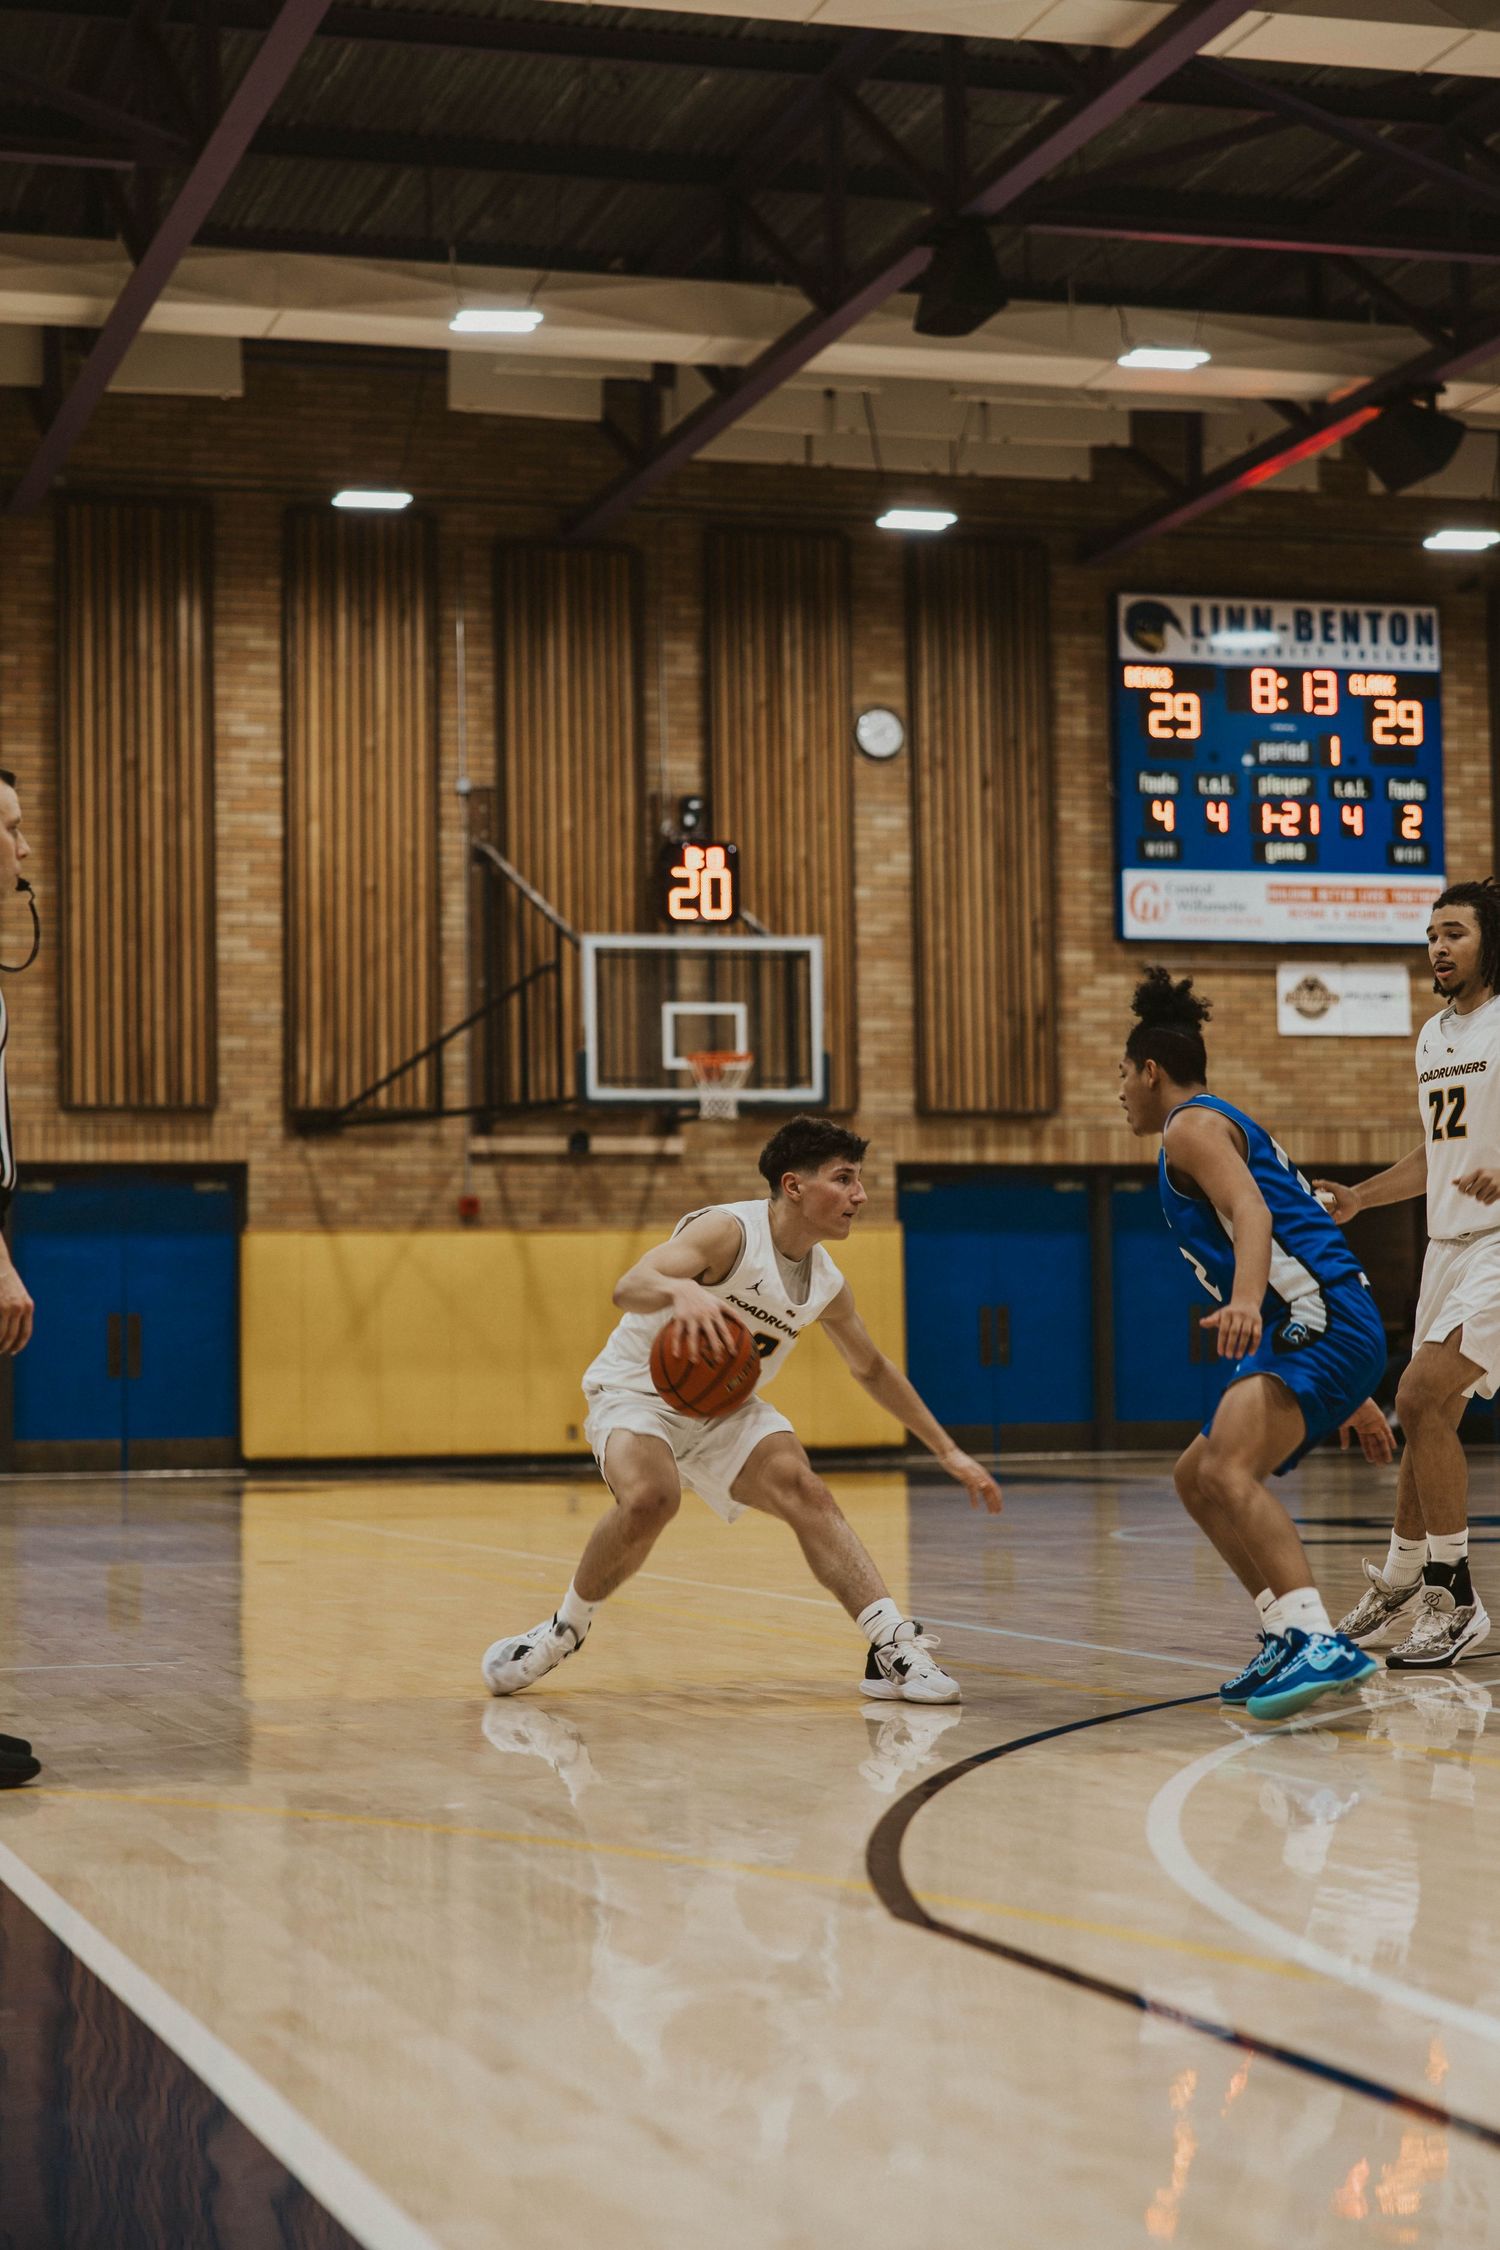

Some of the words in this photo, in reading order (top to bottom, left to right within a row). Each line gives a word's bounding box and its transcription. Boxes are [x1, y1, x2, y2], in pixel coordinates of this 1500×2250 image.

[1190, 603, 1436, 648] LINN-BENTON
[1250, 667, 1339, 716] 8:13
[1148, 691, 1202, 739] 29
[1372, 699, 1424, 746] 29
[1329, 735, 1341, 766] 1
[1152, 799, 1175, 832] 4
[1206, 801, 1229, 833] 4
[1341, 804, 1364, 837] 4
[1401, 804, 1423, 839] 2
[668, 866, 733, 921] 20
[1418, 1060, 1488, 1085] ROADRUNNERS
[1428, 1085, 1468, 1143] 22
[725, 1294, 800, 1340] ROADRUN
